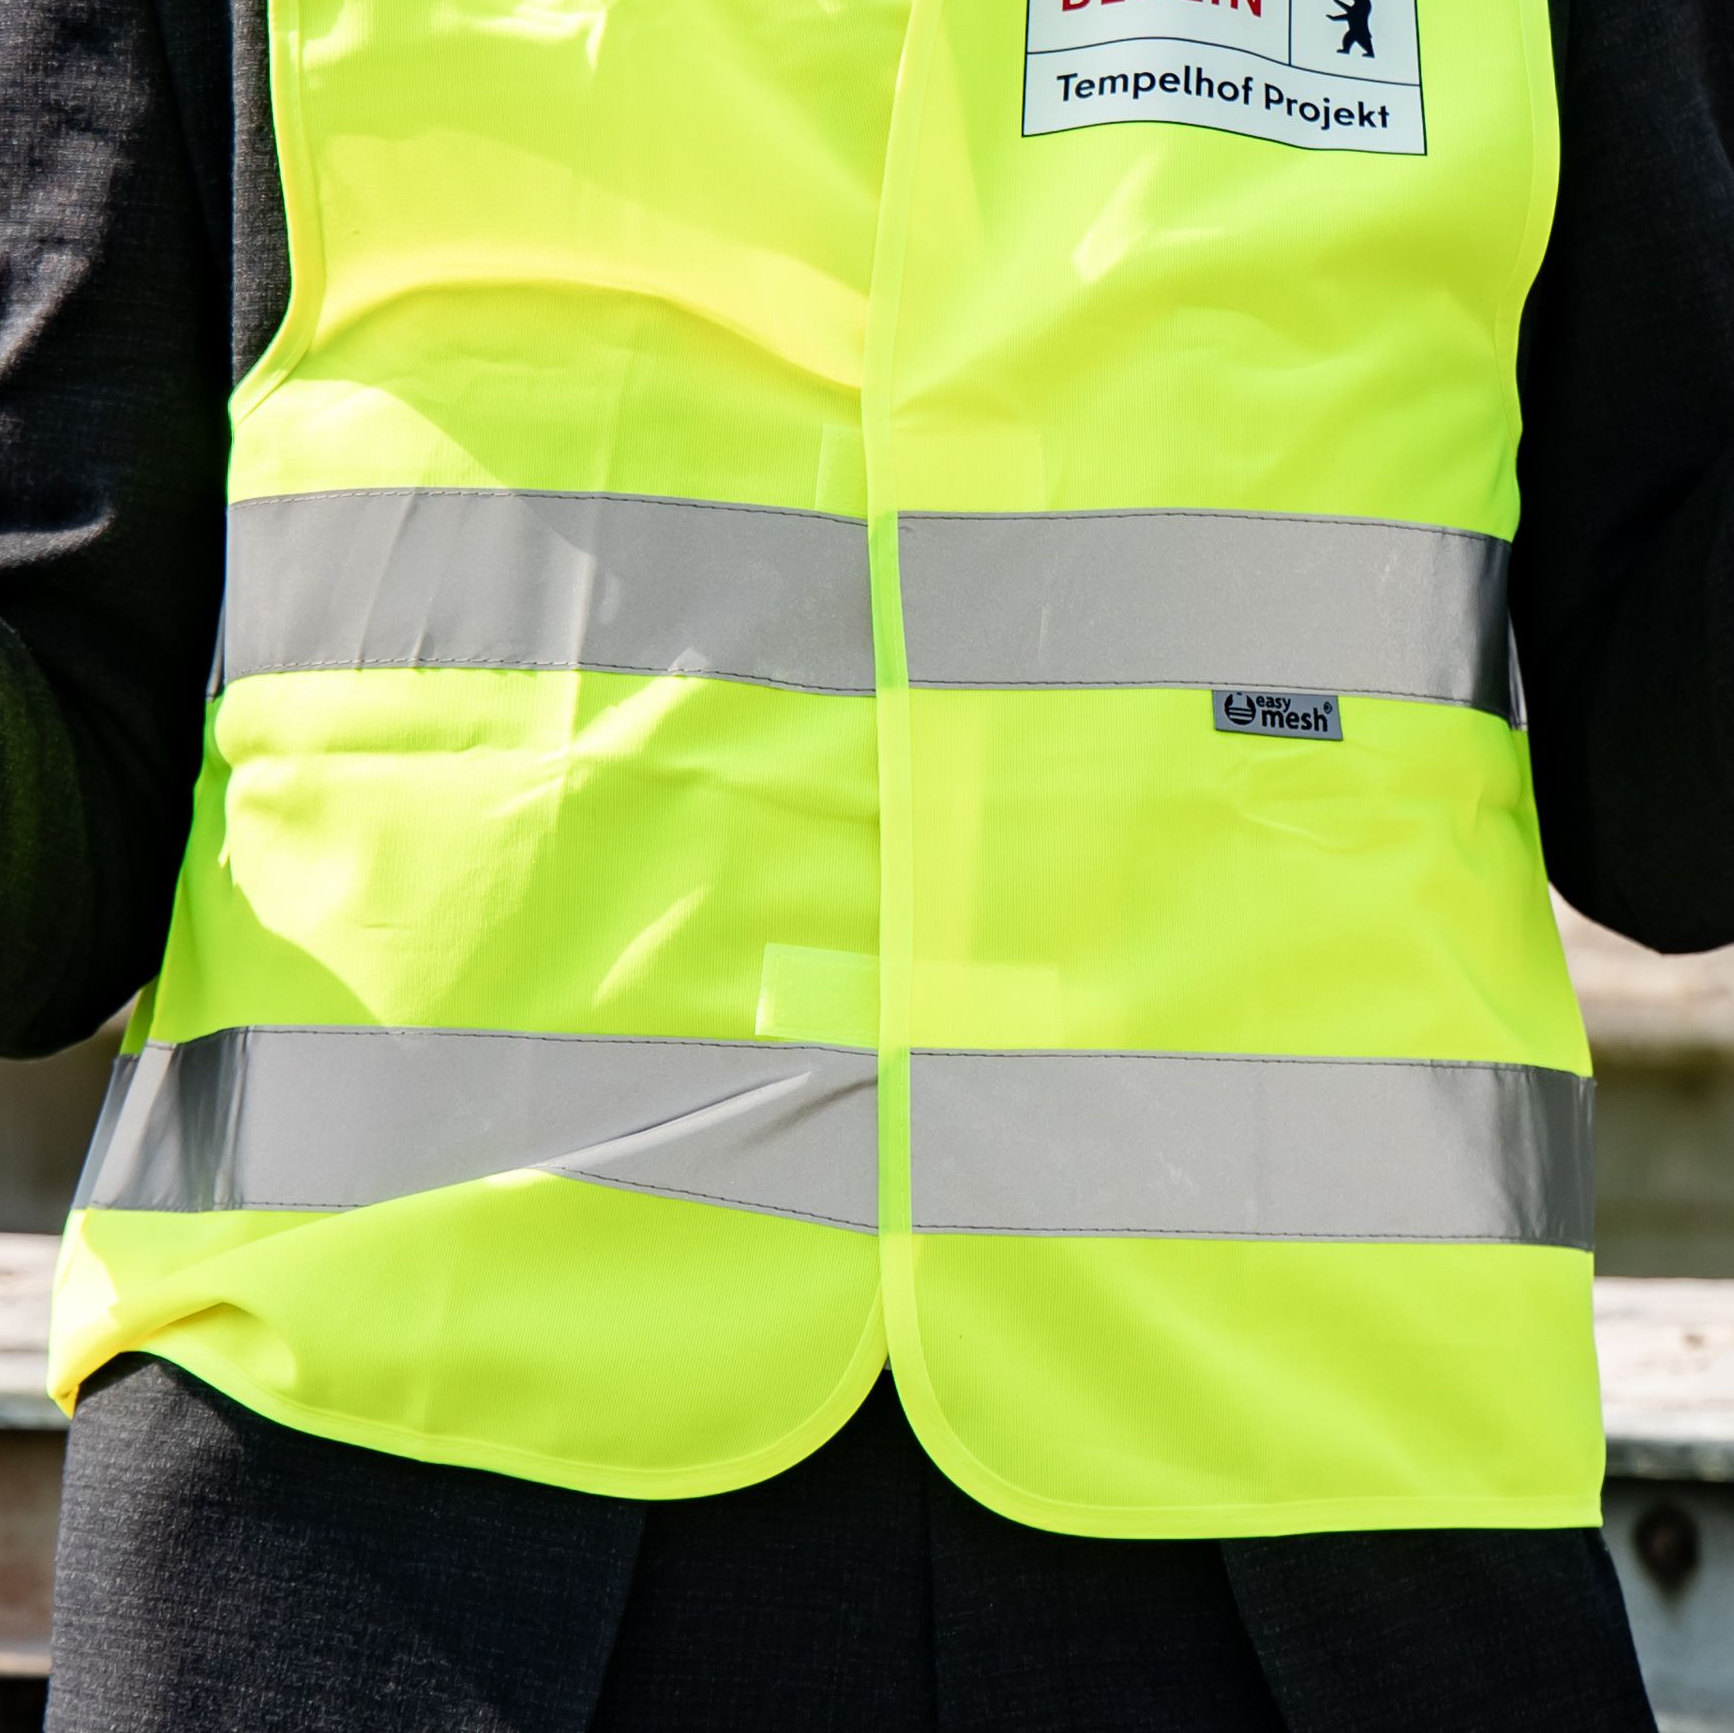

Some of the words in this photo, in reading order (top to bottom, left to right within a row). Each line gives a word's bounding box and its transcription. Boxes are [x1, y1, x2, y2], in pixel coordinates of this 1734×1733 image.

[1056, 65, 1254, 106] Tempelhof
[1264, 82, 1390, 131] Projekt
[1255, 695, 1291, 713] easy
[1261, 707, 1328, 733] mesh
